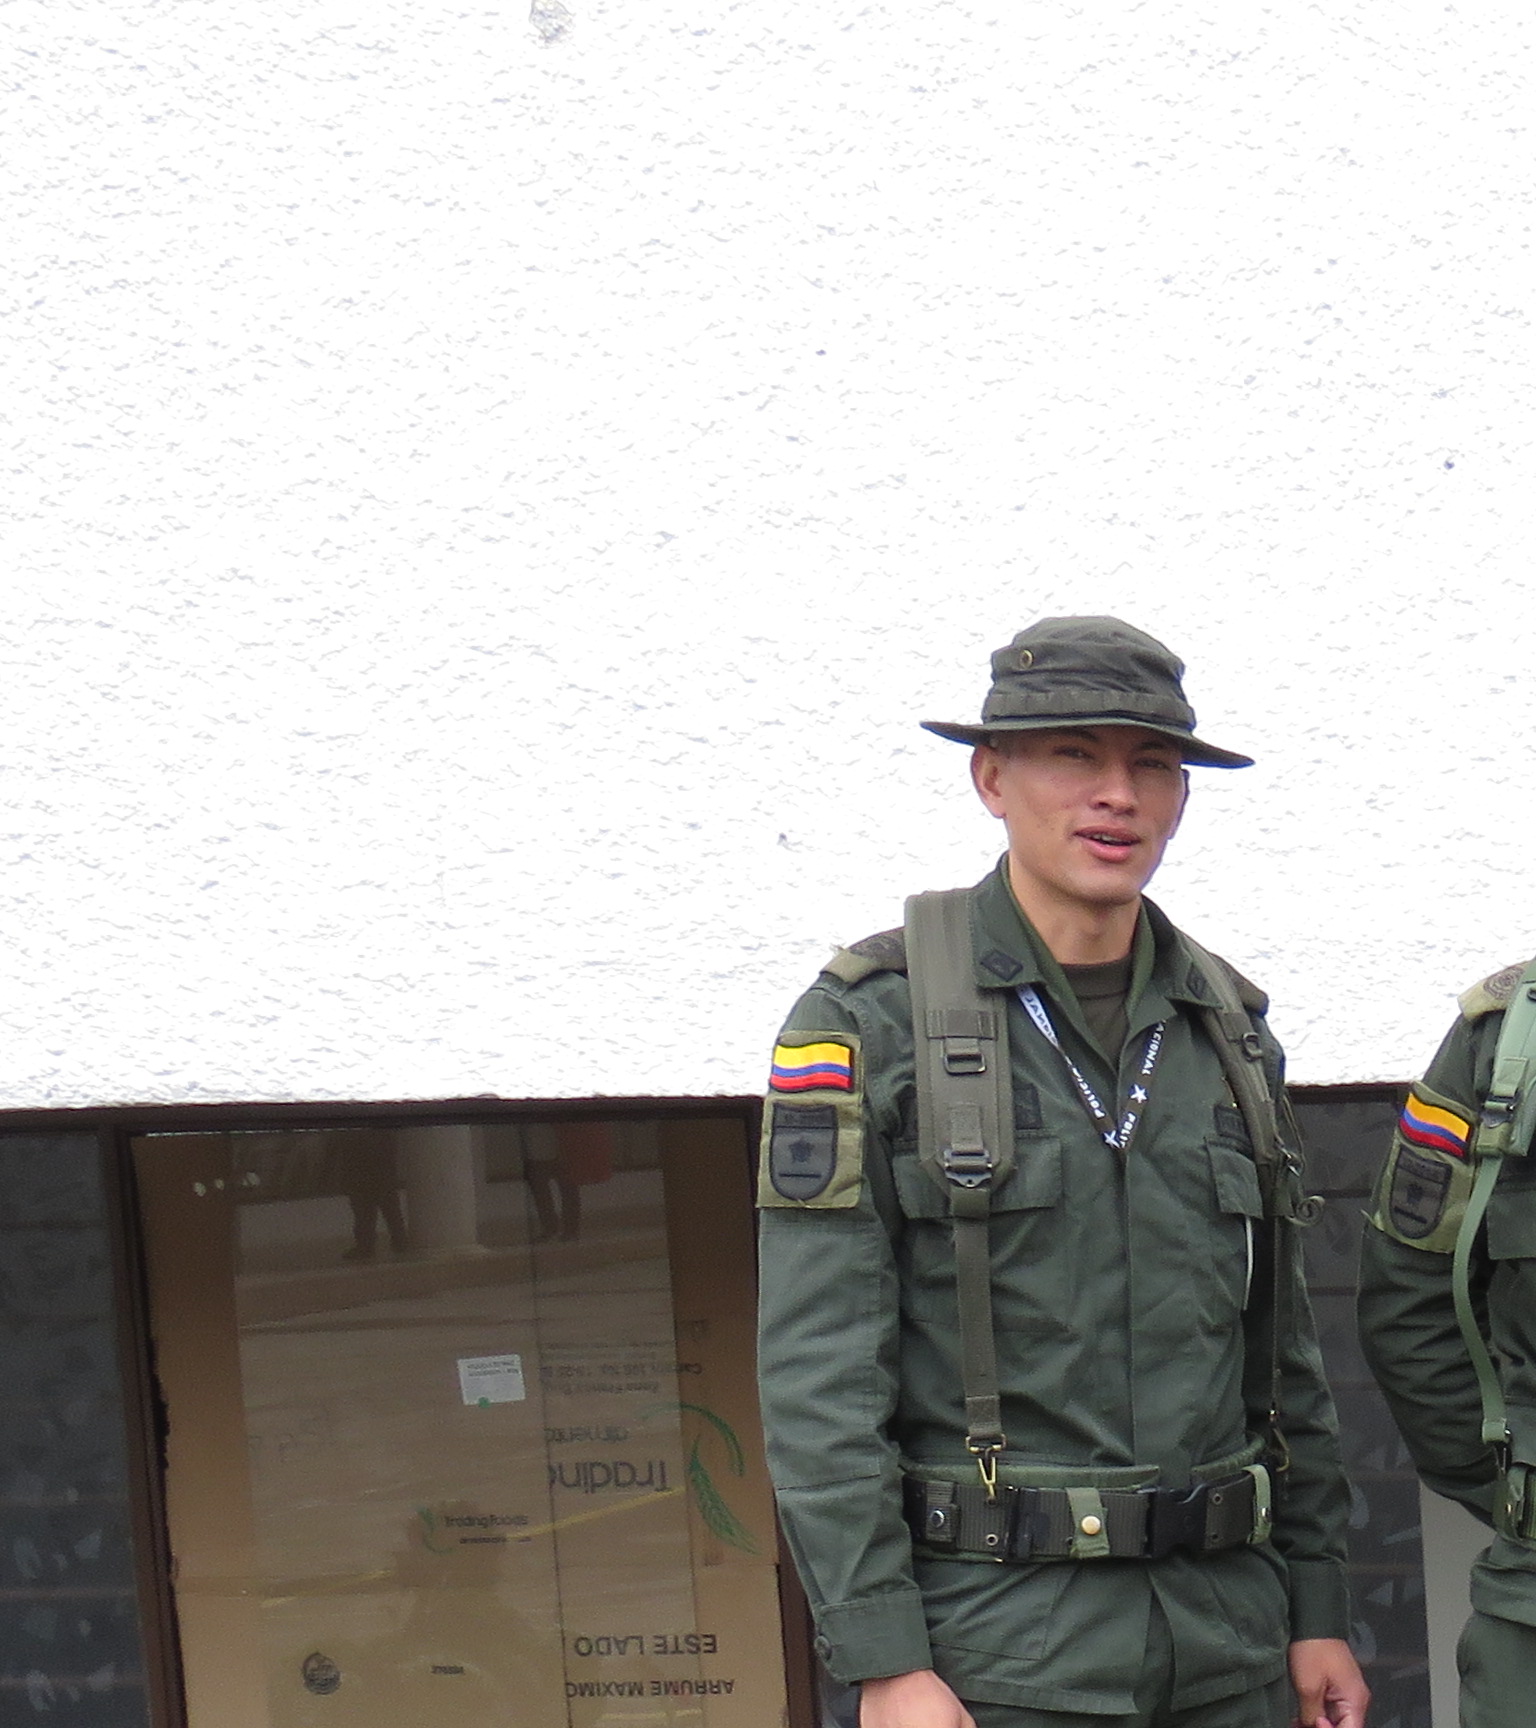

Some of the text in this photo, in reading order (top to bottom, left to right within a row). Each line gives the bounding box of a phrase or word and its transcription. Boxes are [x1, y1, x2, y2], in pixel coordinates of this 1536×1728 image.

[573, 1633, 718, 1658] ESTE LADO
[563, 1678, 736, 1699] ARRUME MAXIMO
